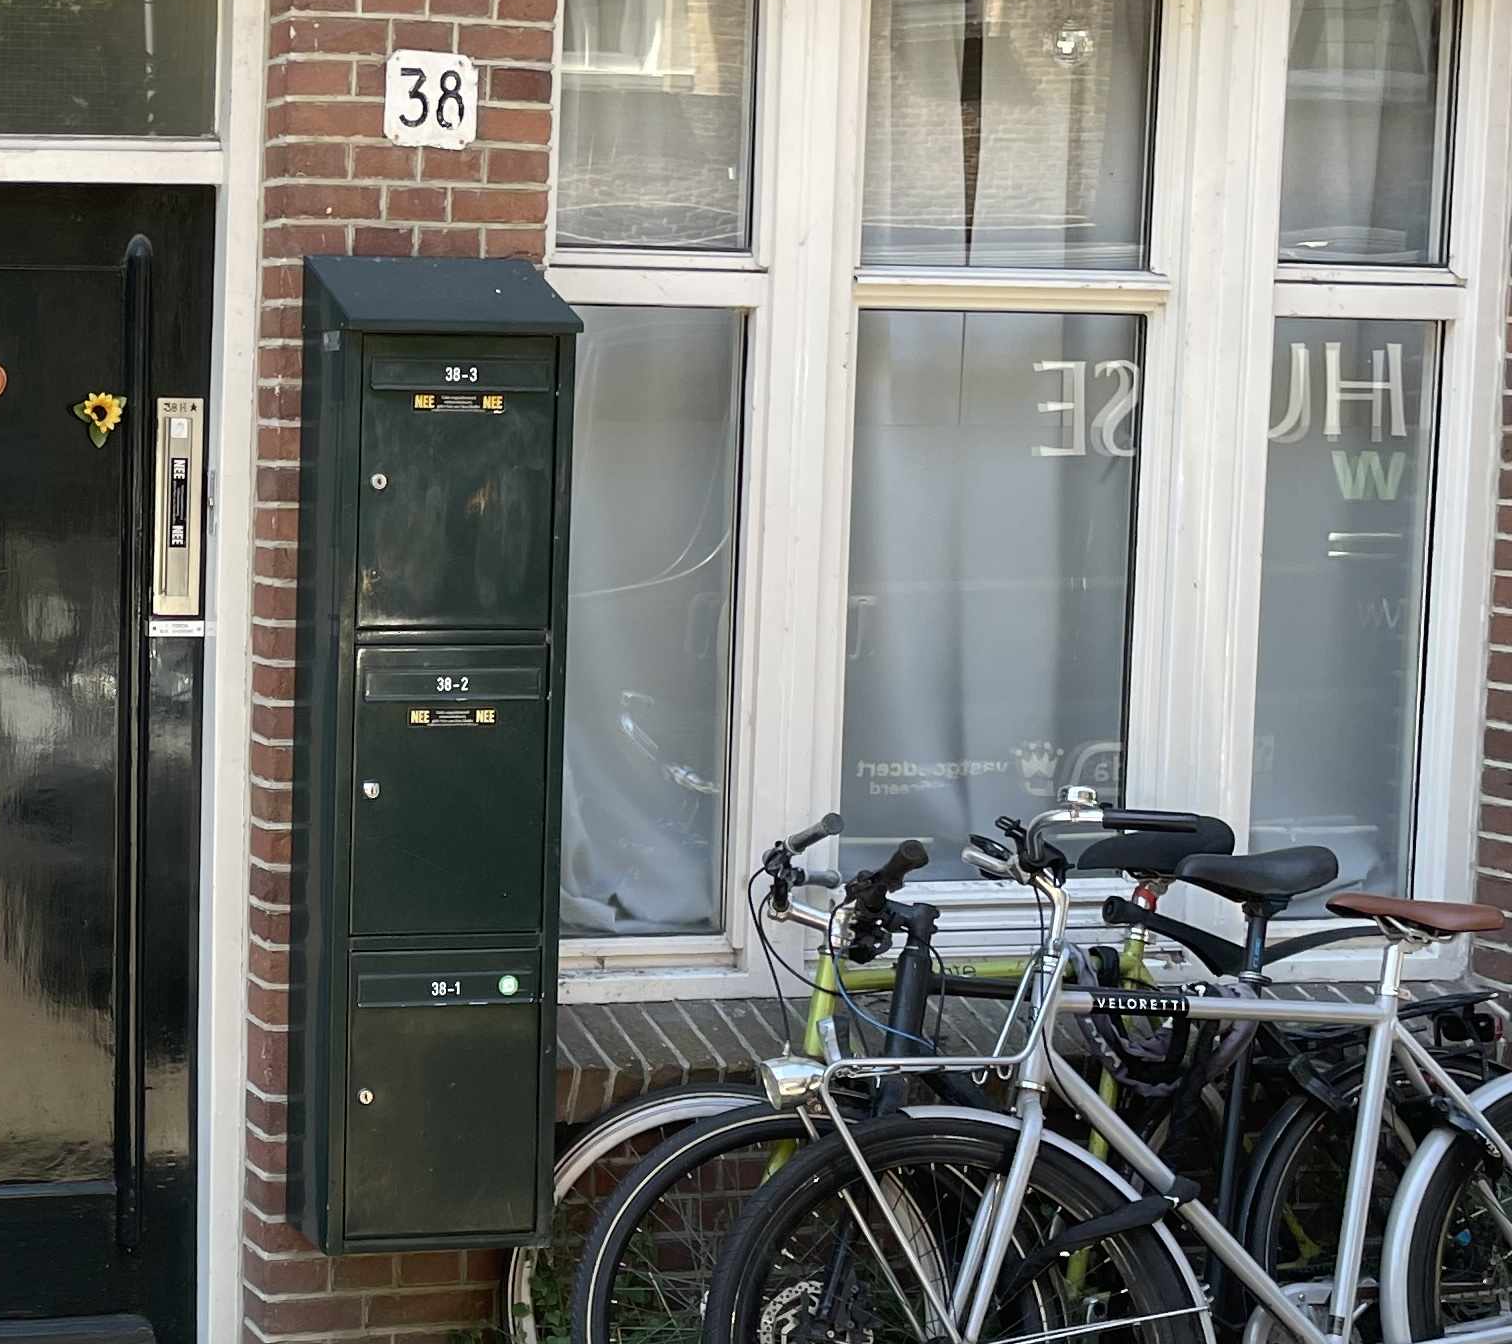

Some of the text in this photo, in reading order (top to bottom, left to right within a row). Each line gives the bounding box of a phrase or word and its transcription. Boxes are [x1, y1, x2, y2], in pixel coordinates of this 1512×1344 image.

[399, 67, 464, 131] 38
[445, 366, 478, 382] 38-3
[414, 394, 436, 409] NEE
[482, 395, 504, 410] NEE
[436, 676, 469, 692] 38-2
[410, 710, 430, 724] NEE
[475, 709, 495, 723] NEE
[431, 981, 461, 996] 38-1
[1097, 997, 1186, 1011] VELORETTI
